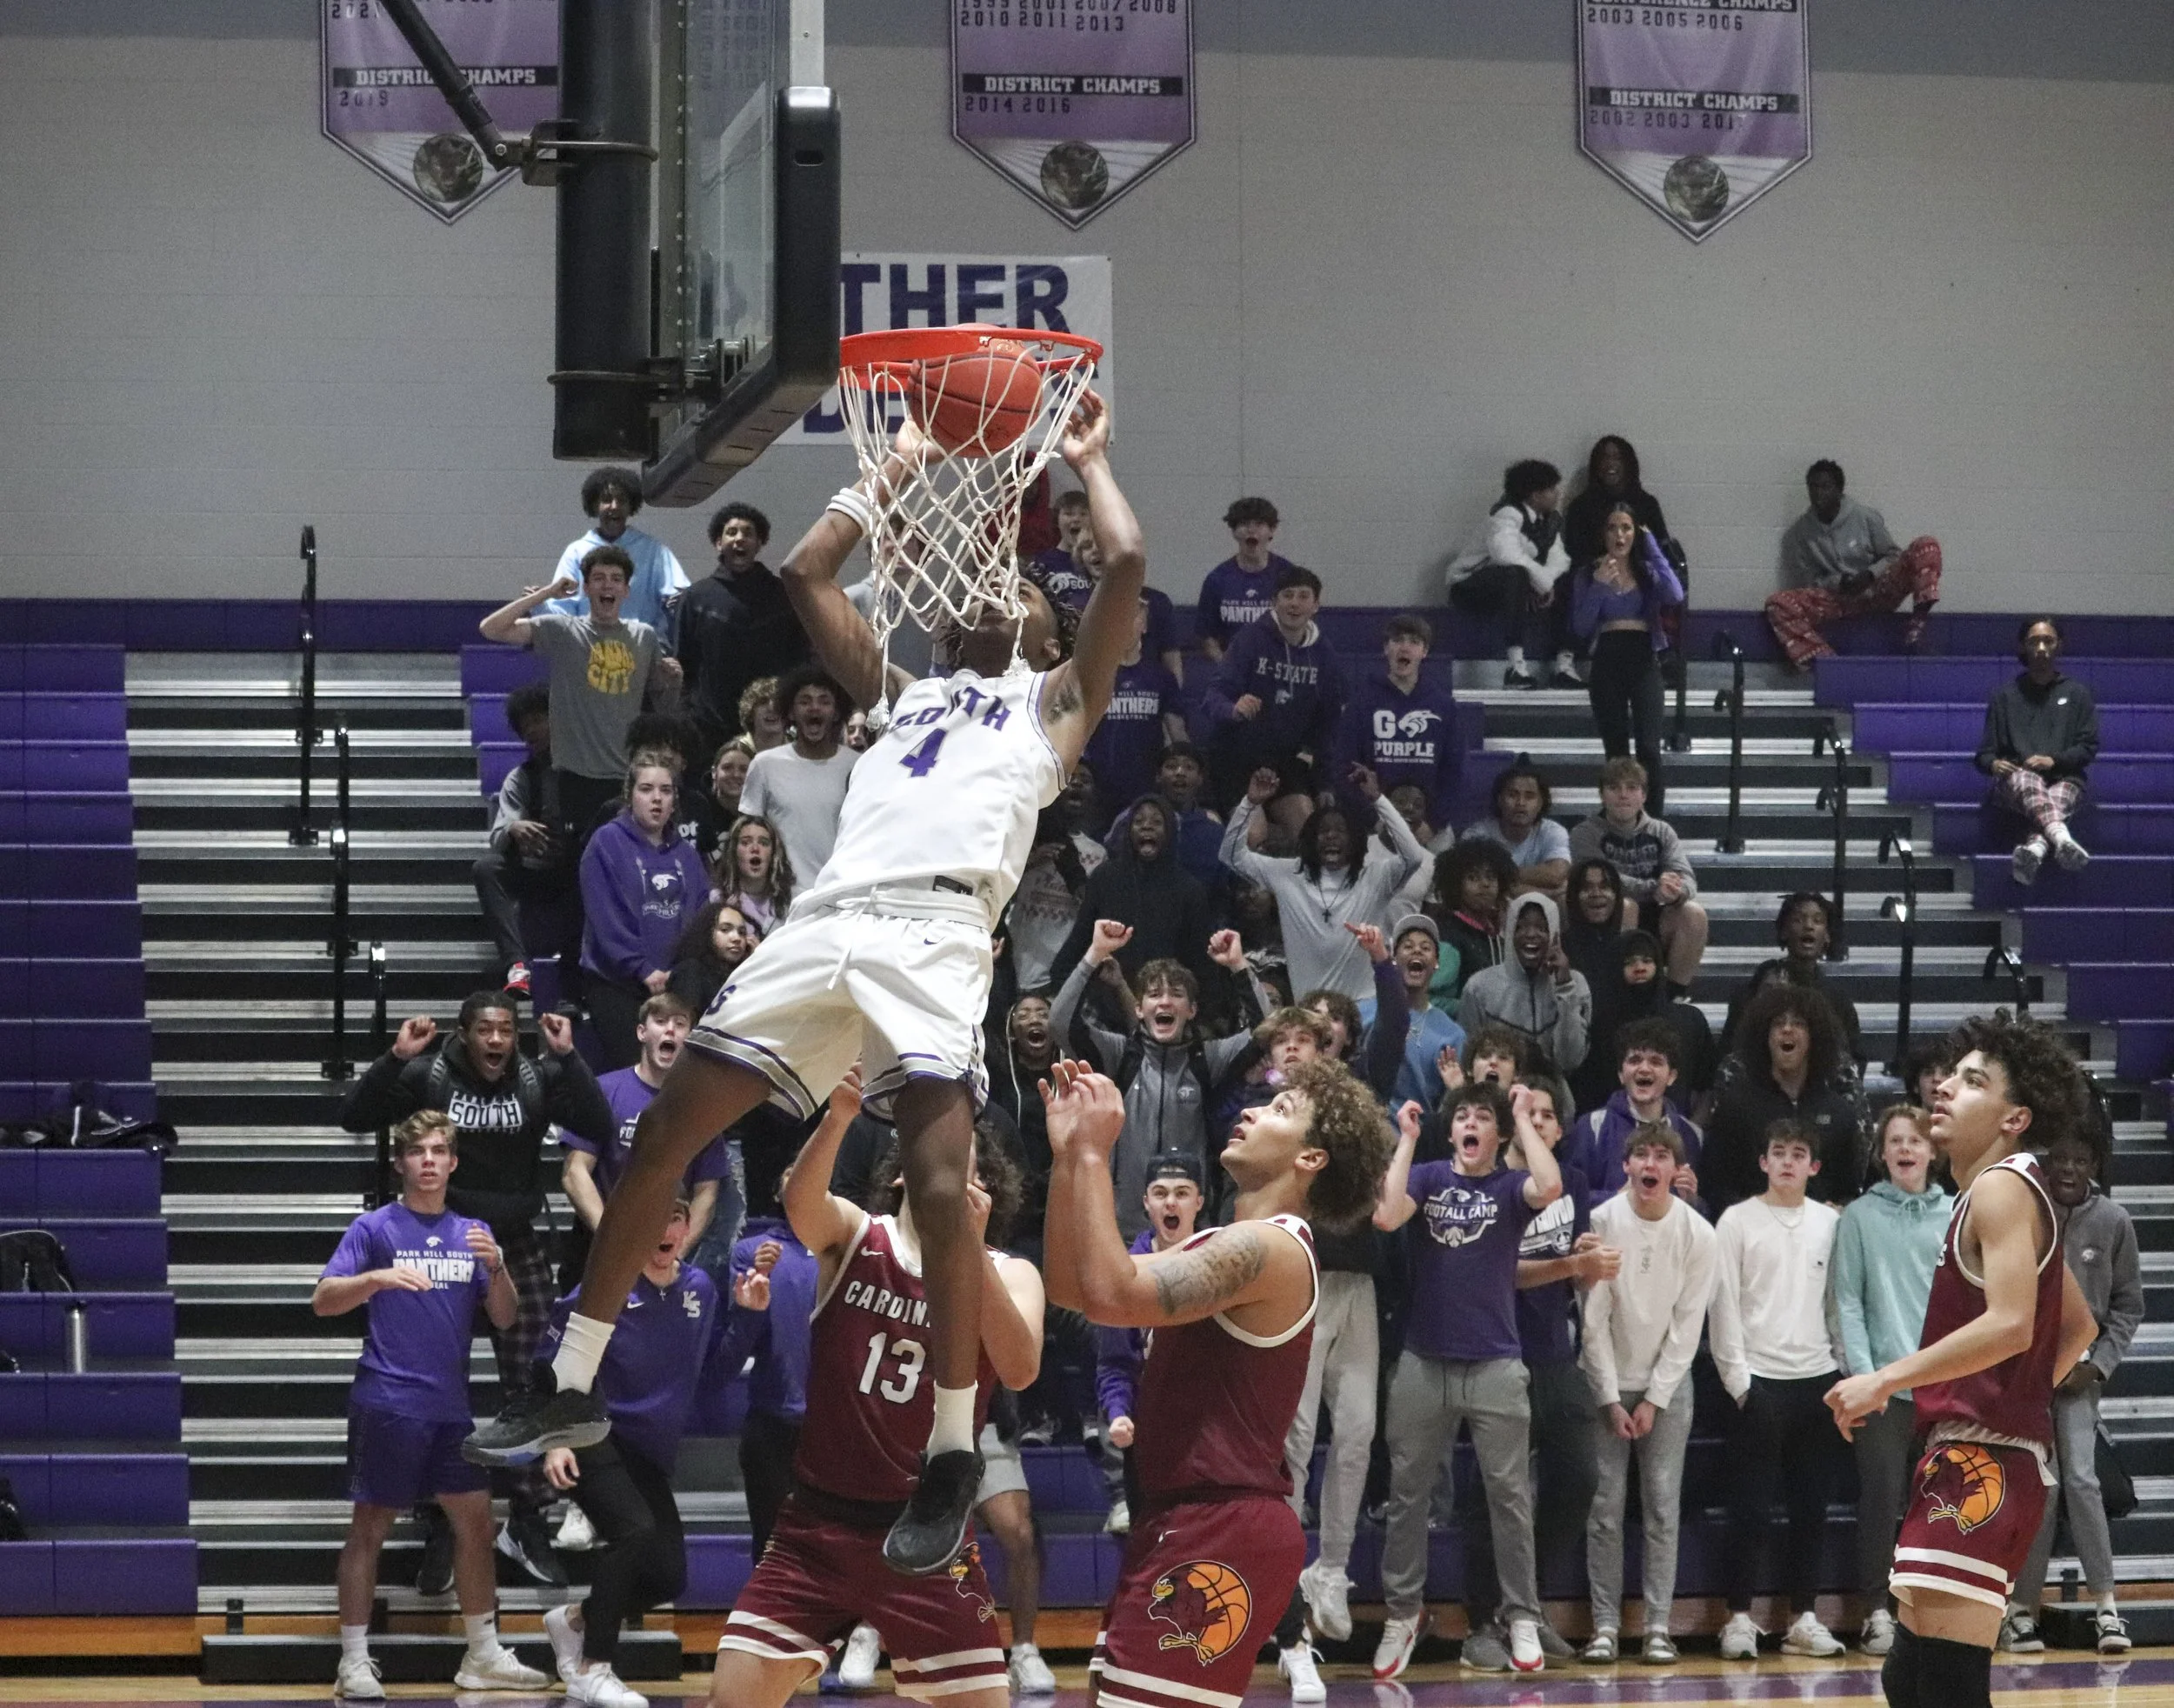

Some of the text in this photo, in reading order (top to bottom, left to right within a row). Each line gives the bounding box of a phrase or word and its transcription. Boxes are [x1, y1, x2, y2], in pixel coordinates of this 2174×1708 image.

[961, 10, 1124, 31] 2010 2011 2013
[1588, 8, 1743, 31] 2003 2005 2006
[356, 68, 536, 86] DISTRIC HAMPS
[984, 76, 1161, 95] DISTRICT CHAMPS
[964, 96, 1070, 114] 2014 2016
[1610, 90, 1778, 110] DISTRICT CHAMPS
[840, 264, 1071, 334] THER
[1220, 605, 1272, 624] PANTH
[1256, 657, 1319, 684] K-STATE
[1105, 697, 1160, 715] NTHERS
[899, 727, 948, 778] 4
[1374, 741, 1435, 757] PURPLE
[451, 1102, 520, 1128] SOUTH
[1468, 1204, 1498, 1219] CAMP
[446, 1251, 474, 1260] SOUTH
[844, 1280, 931, 1329] CARDIN
[858, 1331, 927, 1404] 13
